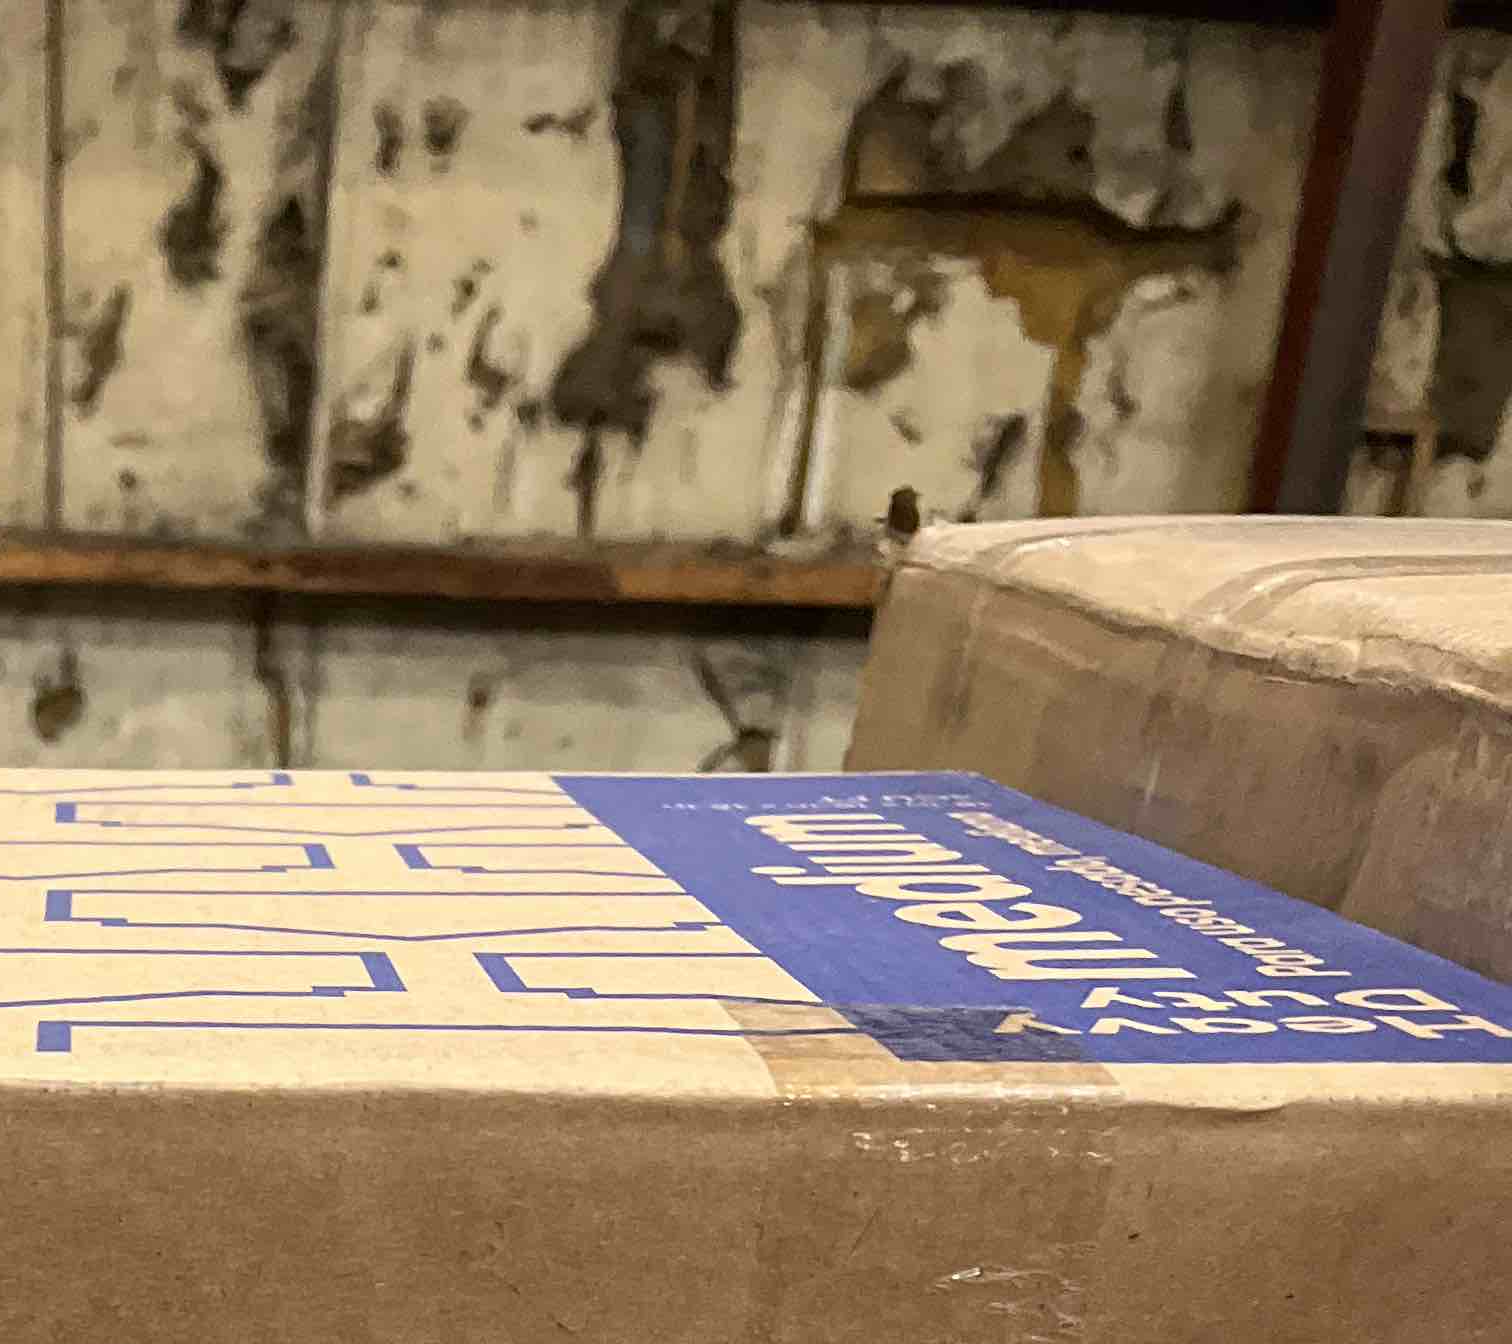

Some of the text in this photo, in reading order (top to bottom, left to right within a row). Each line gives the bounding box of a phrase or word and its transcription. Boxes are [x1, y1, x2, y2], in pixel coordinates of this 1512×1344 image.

[745, 812, 1197, 981] medium
[1080, 986, 1463, 1012] Duty
[994, 1012, 1512, 1039] Heavy
